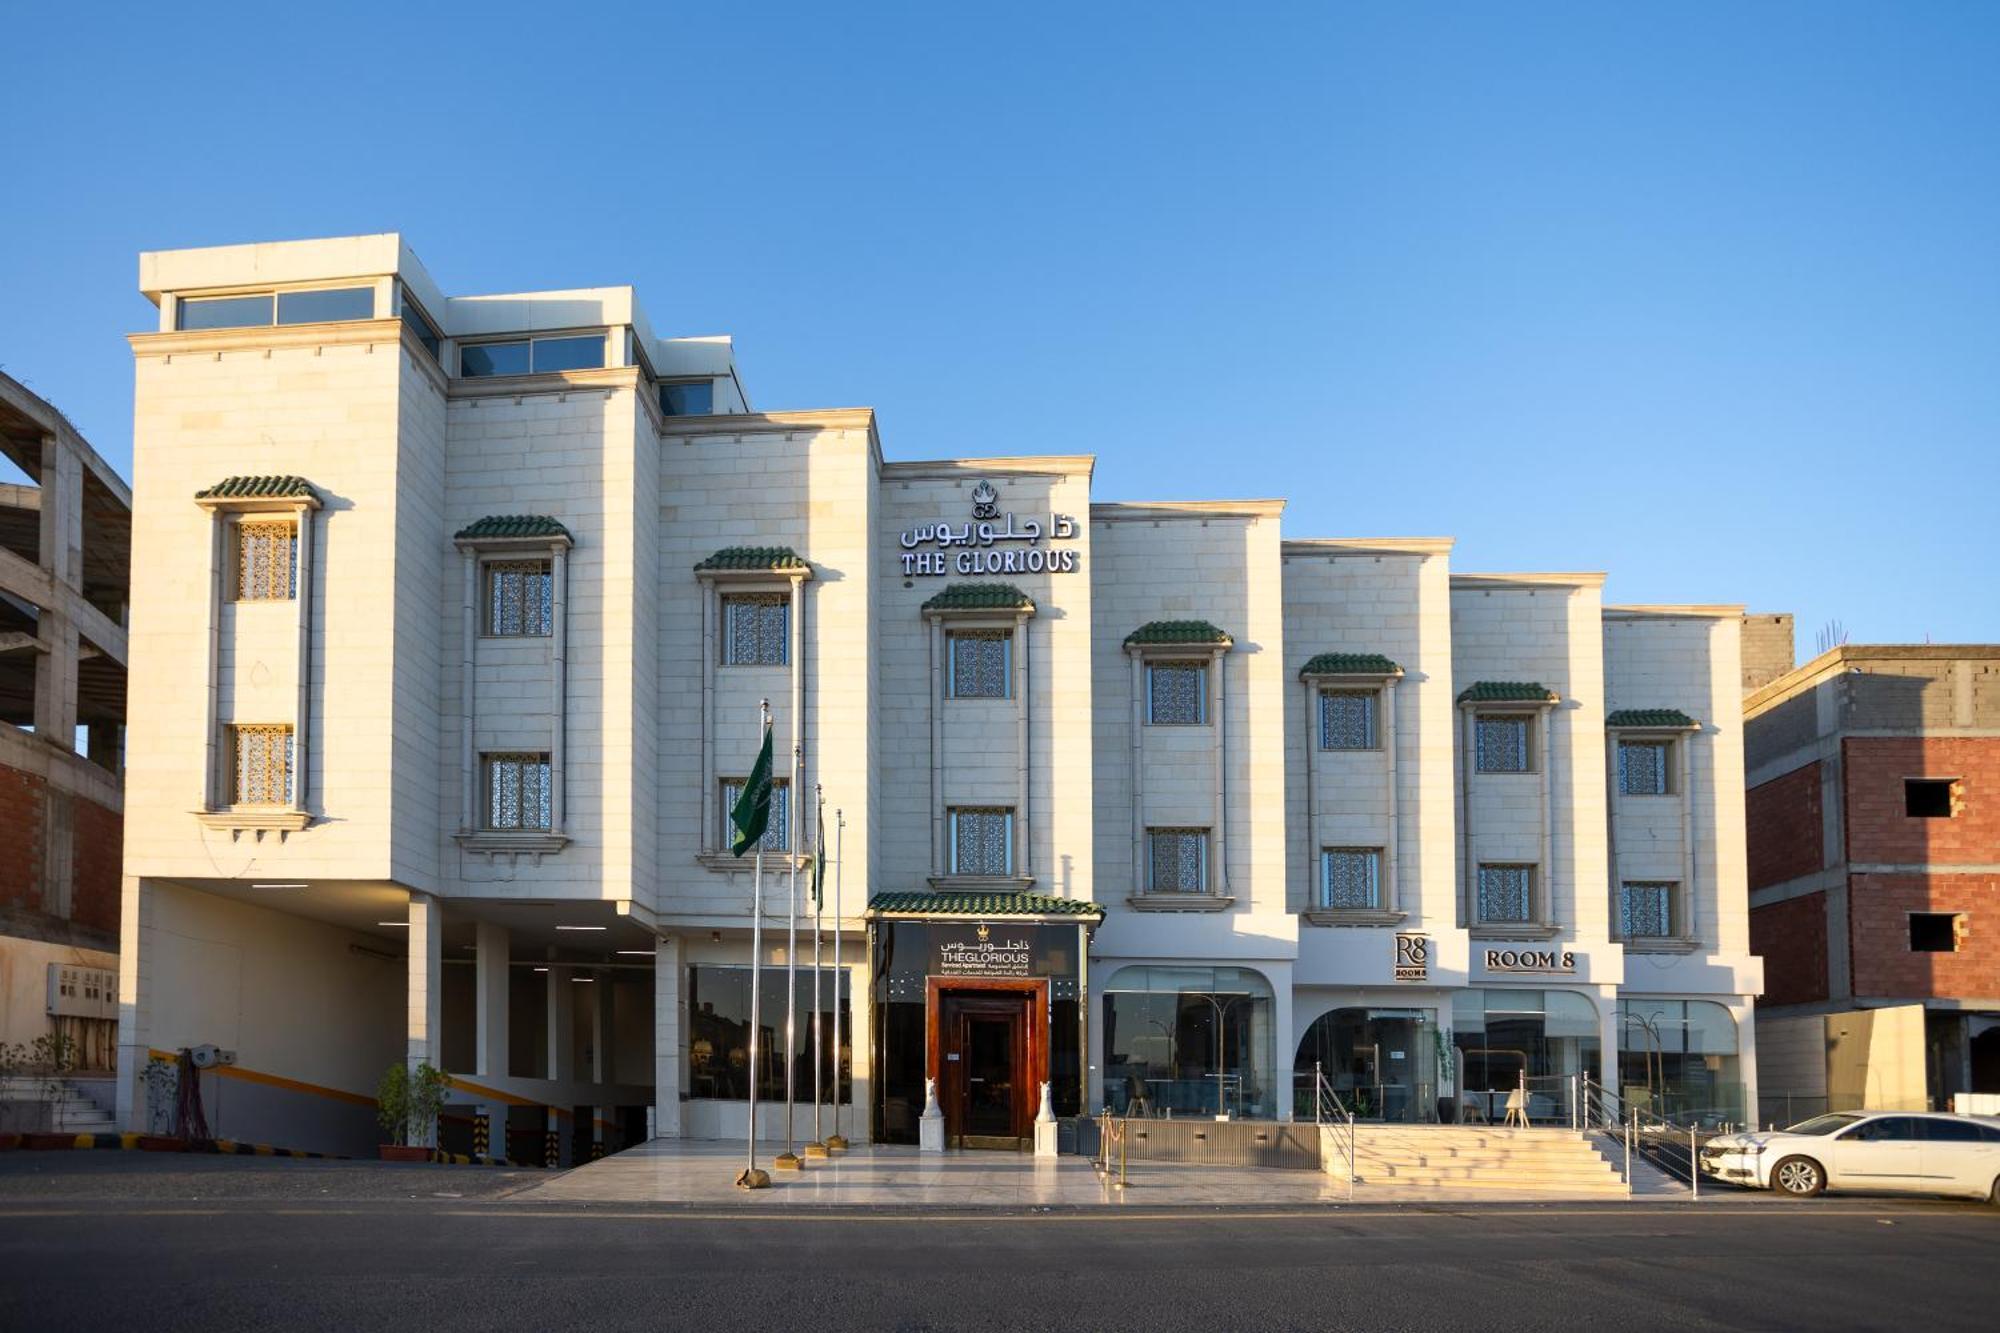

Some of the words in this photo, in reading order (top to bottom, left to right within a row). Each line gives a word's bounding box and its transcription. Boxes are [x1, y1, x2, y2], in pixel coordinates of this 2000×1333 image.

[1050, 512, 1073, 538] ذا
[902, 552, 946, 575] THE
[956, 550, 1073, 574] GLORIOUS
[1487, 950, 1555, 967] ROOM
[1563, 951, 1576, 968] 8
